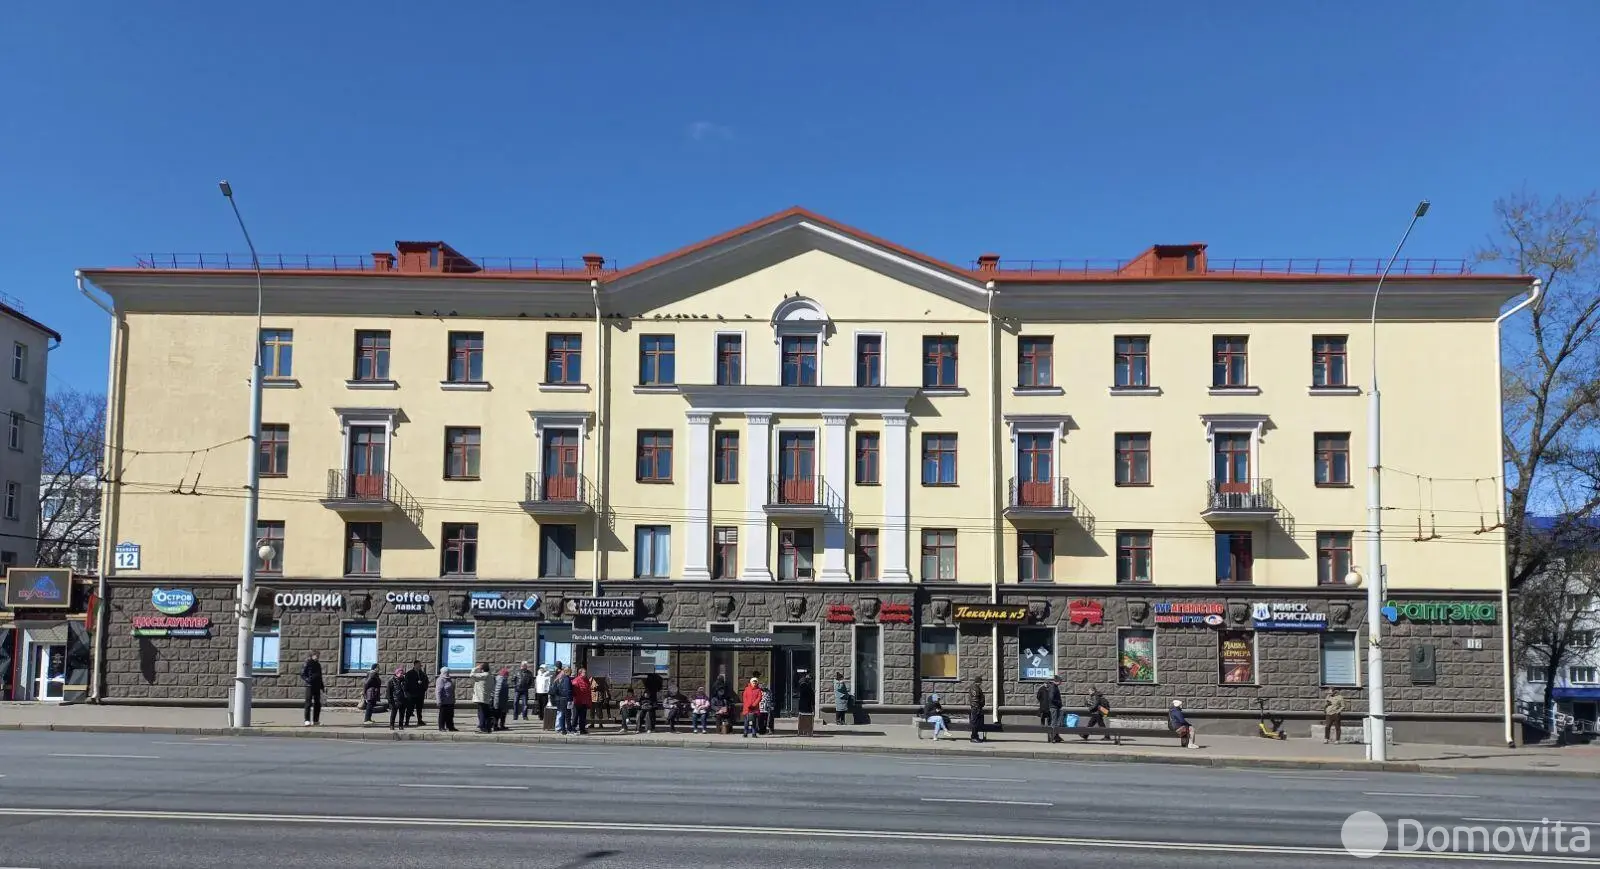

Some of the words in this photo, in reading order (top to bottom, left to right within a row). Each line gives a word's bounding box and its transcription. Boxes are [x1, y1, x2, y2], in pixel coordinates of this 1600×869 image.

[118, 553, 134, 567] 12
[274, 592, 342, 607] СОЛЯРИЙ
[385, 591, 430, 602] Coffee
[394, 603, 422, 611] лавка
[471, 599, 523, 609] РЕМОНТ
[579, 600, 634, 608] ГРАНИТНАЯ
[1273, 603, 1308, 611] МИНСК
[579, 608, 634, 616] МАСТЕРСКАЯ
[955, 606, 1007, 620] Пекарня
[1405, 602, 1496, 620] аптэка
[1273, 612, 1326, 621] КРИСТАЛЛ
[133, 616, 209, 628] ДИСКАУНТЕР
[1224, 641, 1247, 650] ЛАВКА
